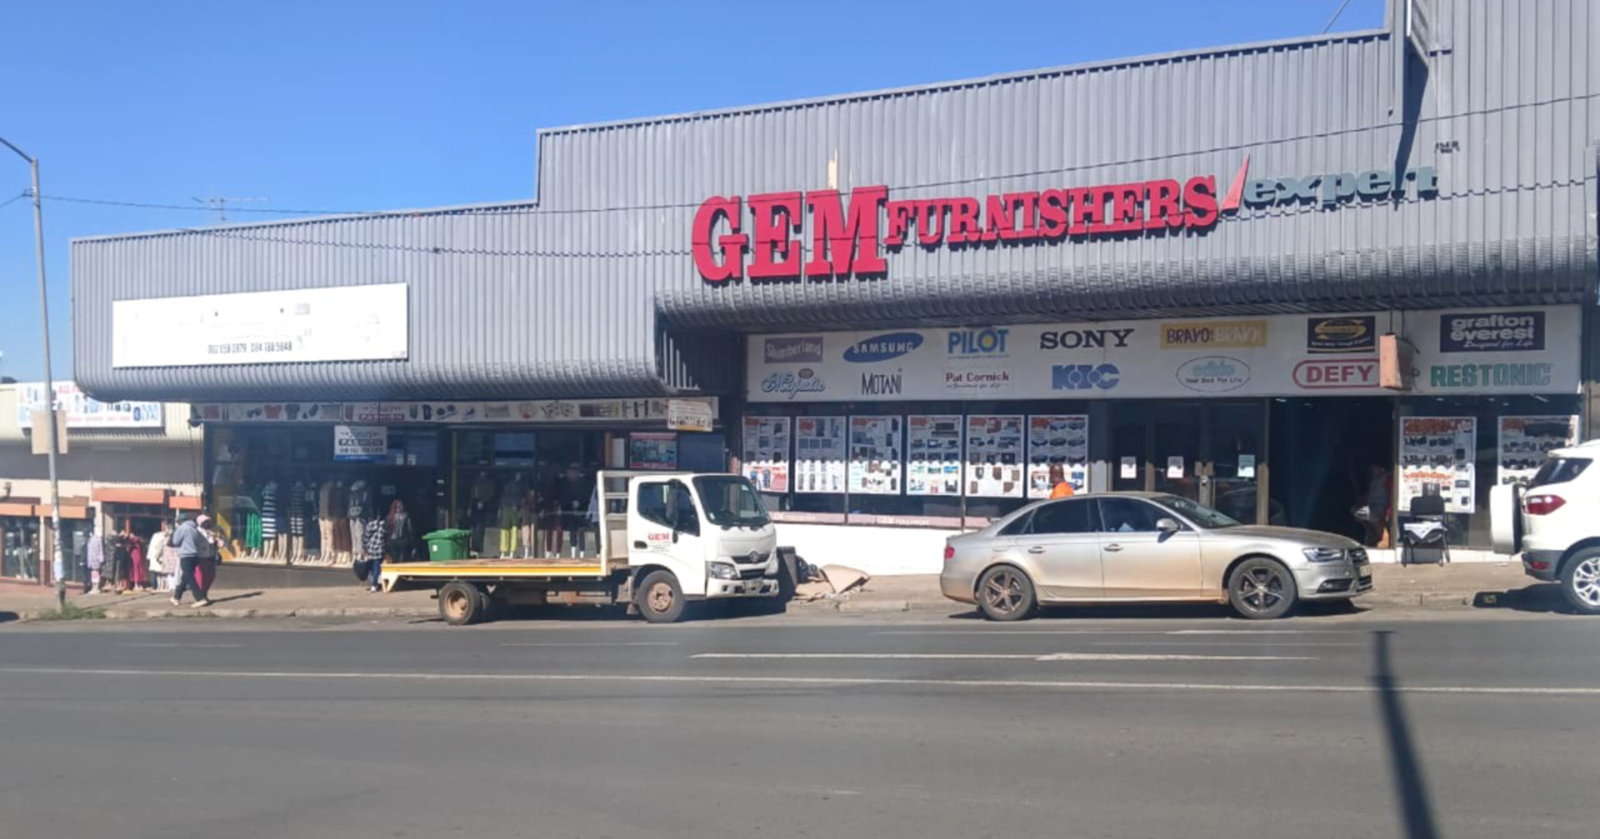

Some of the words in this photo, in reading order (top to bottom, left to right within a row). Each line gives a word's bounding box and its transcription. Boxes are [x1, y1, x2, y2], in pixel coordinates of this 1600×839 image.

[691, 184, 888, 281] GEM
[883, 174, 1218, 246] FURNISHERS
[1243, 165, 1438, 208] expert
[1451, 314, 1535, 331] grafton
[947, 328, 1009, 354] PILOT
[1039, 328, 1135, 350] SONY
[1166, 327, 1214, 345] BRAVO!
[1214, 325, 1262, 343] BRAVO!
[1450, 328, 1535, 341] everest
[766, 340, 821, 359] Slumberland
[852, 341, 915, 355] SAMSUNG
[945, 371, 963, 383] Pat
[966, 369, 1010, 383] Cornick
[1053, 364, 1120, 389] KIC
[1305, 365, 1374, 383] DEFY
[1430, 363, 1552, 387] RESTONIC
[360, 413, 403, 421] FASHION
[647, 533, 670, 541] GEM
